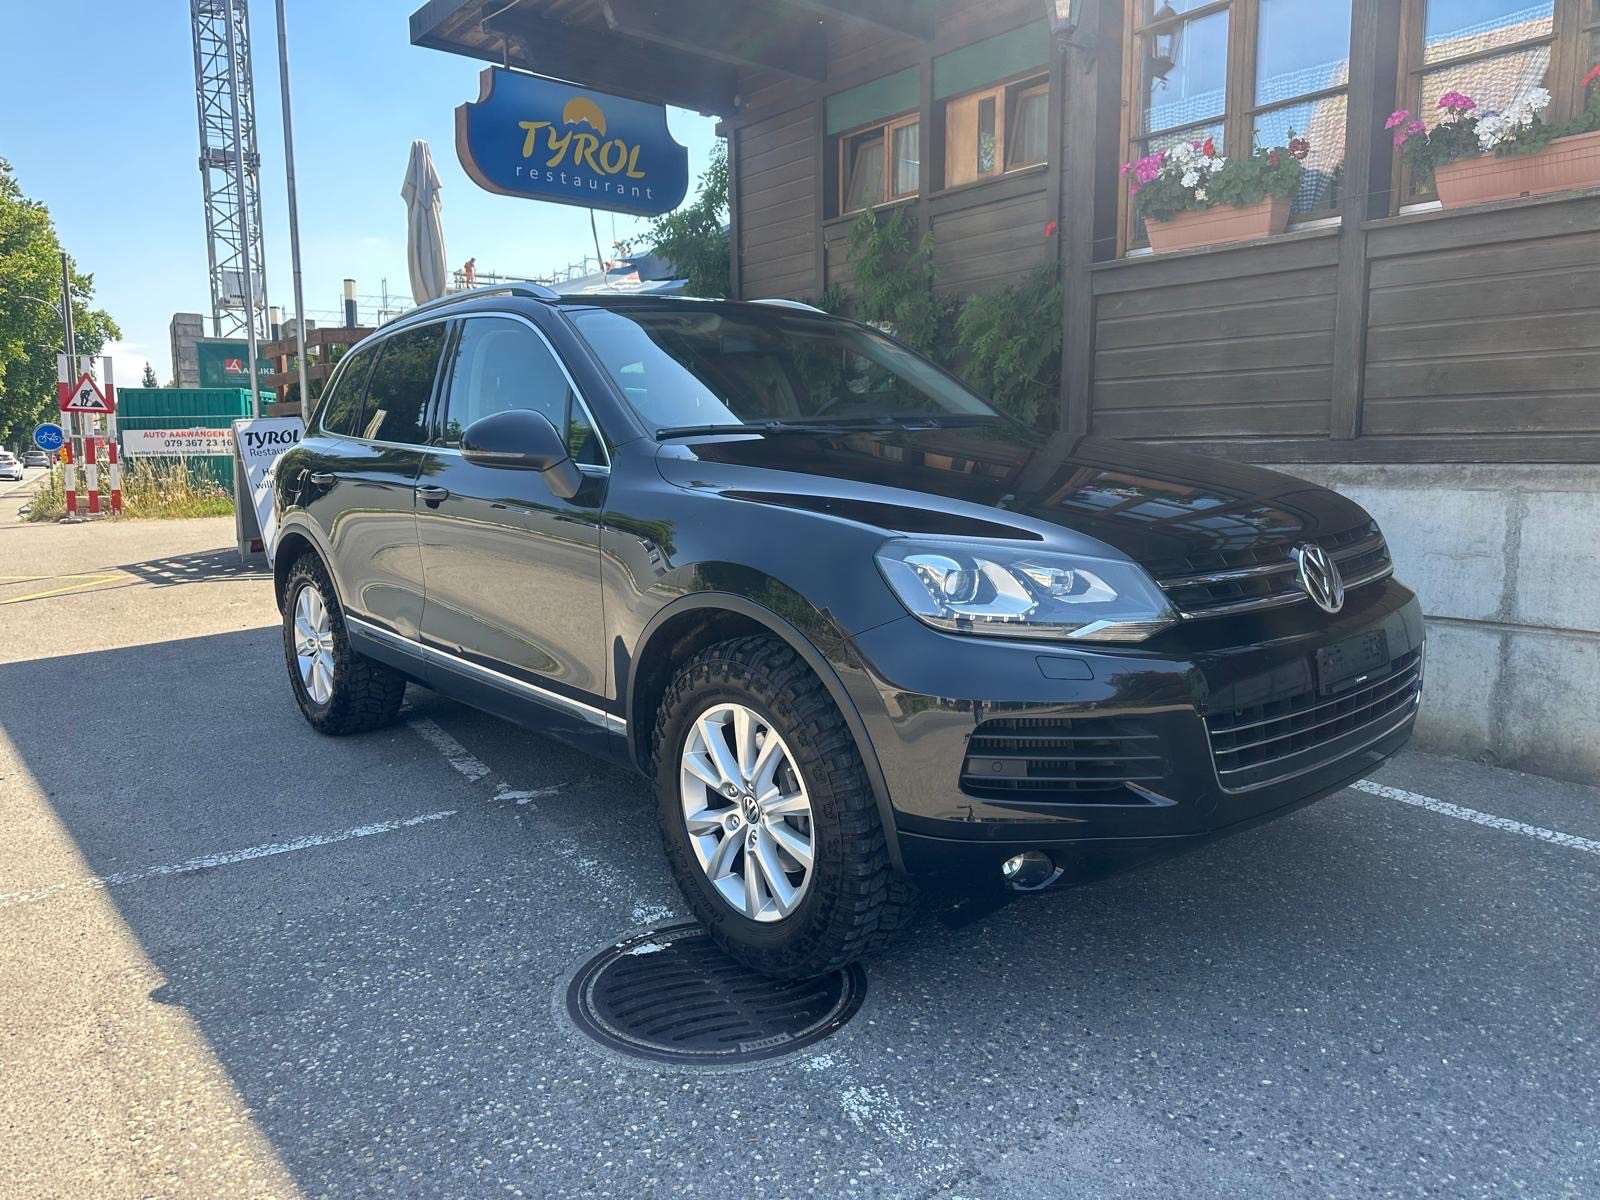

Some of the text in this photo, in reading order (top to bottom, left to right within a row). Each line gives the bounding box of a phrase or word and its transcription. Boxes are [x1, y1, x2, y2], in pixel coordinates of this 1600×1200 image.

[518, 120, 646, 178] TYROL
[515, 164, 652, 199] restaurant
[143, 431, 166, 439] AUTO
[164, 439, 182, 447] 079
[185, 439, 203, 447] 367
[221, 438, 233, 446] 16
[244, 429, 301, 449] TYROL
